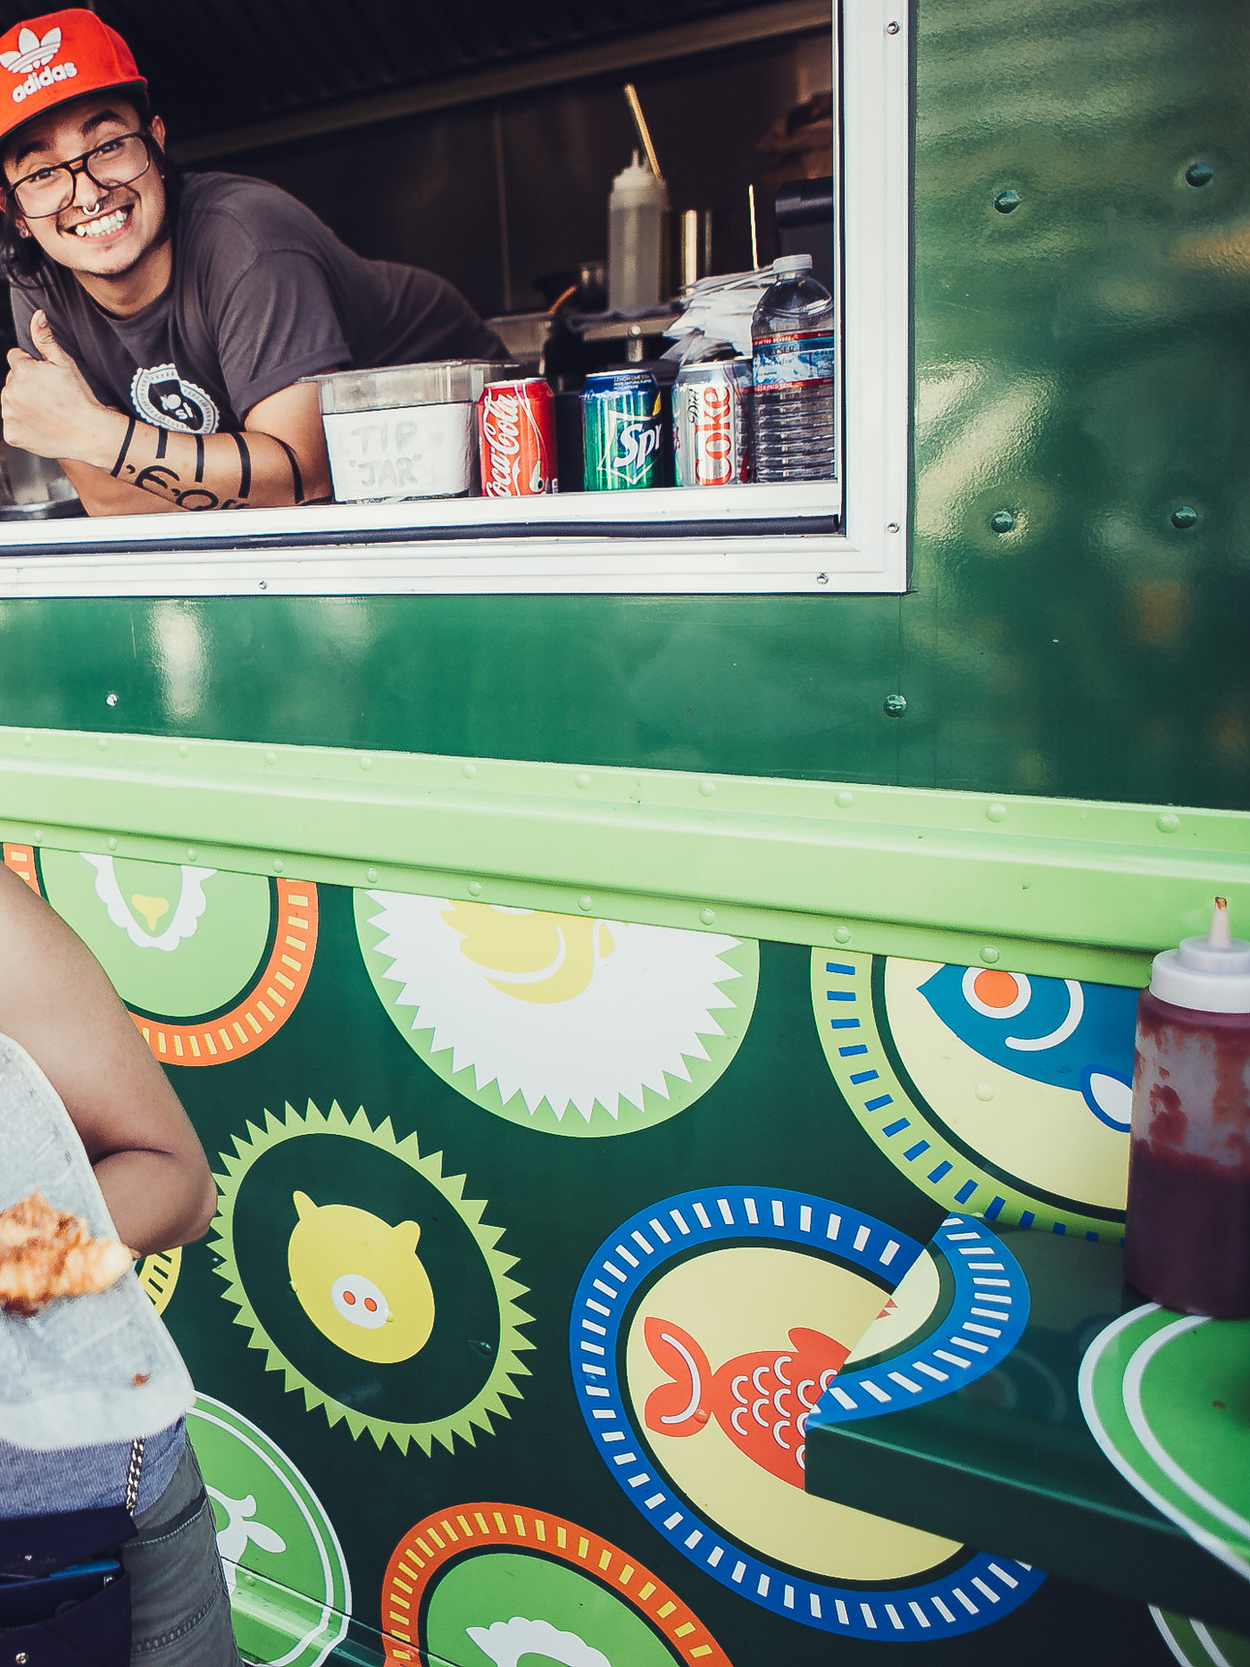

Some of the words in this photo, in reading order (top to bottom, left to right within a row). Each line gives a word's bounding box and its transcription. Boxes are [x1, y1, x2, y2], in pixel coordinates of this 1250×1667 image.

[12, 62, 78, 102] adidas
[351, 421, 418, 455] TIP
[695, 386, 732, 486] Coke
